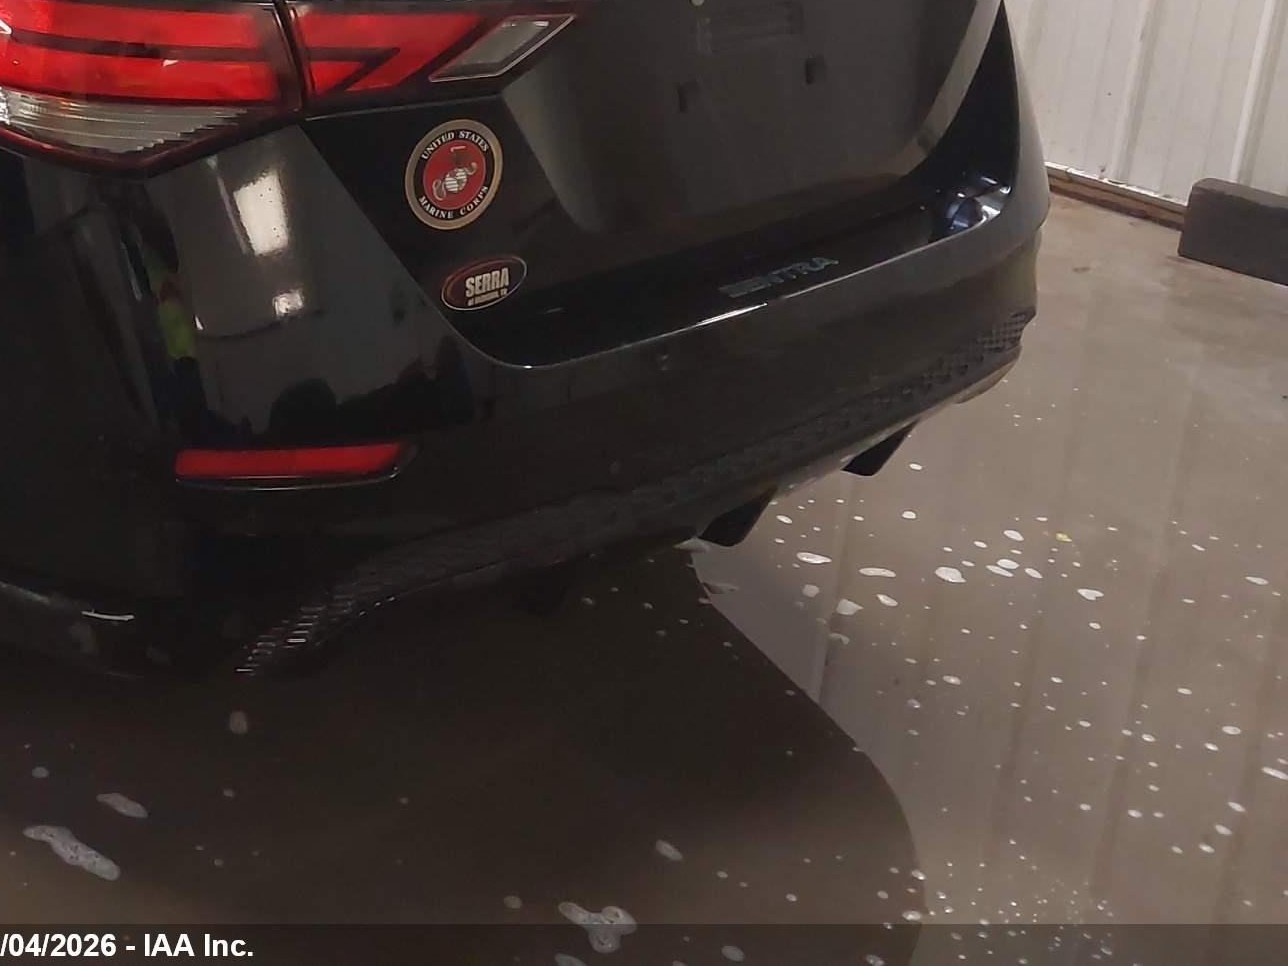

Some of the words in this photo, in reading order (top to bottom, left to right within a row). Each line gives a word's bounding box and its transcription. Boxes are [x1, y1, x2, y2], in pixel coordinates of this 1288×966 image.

[421, 131, 455, 160] UNITED
[458, 130, 489, 152] STATES
[418, 195, 454, 219] MARINE
[459, 185, 489, 215] CORPS
[465, 267, 509, 298] SERRA
